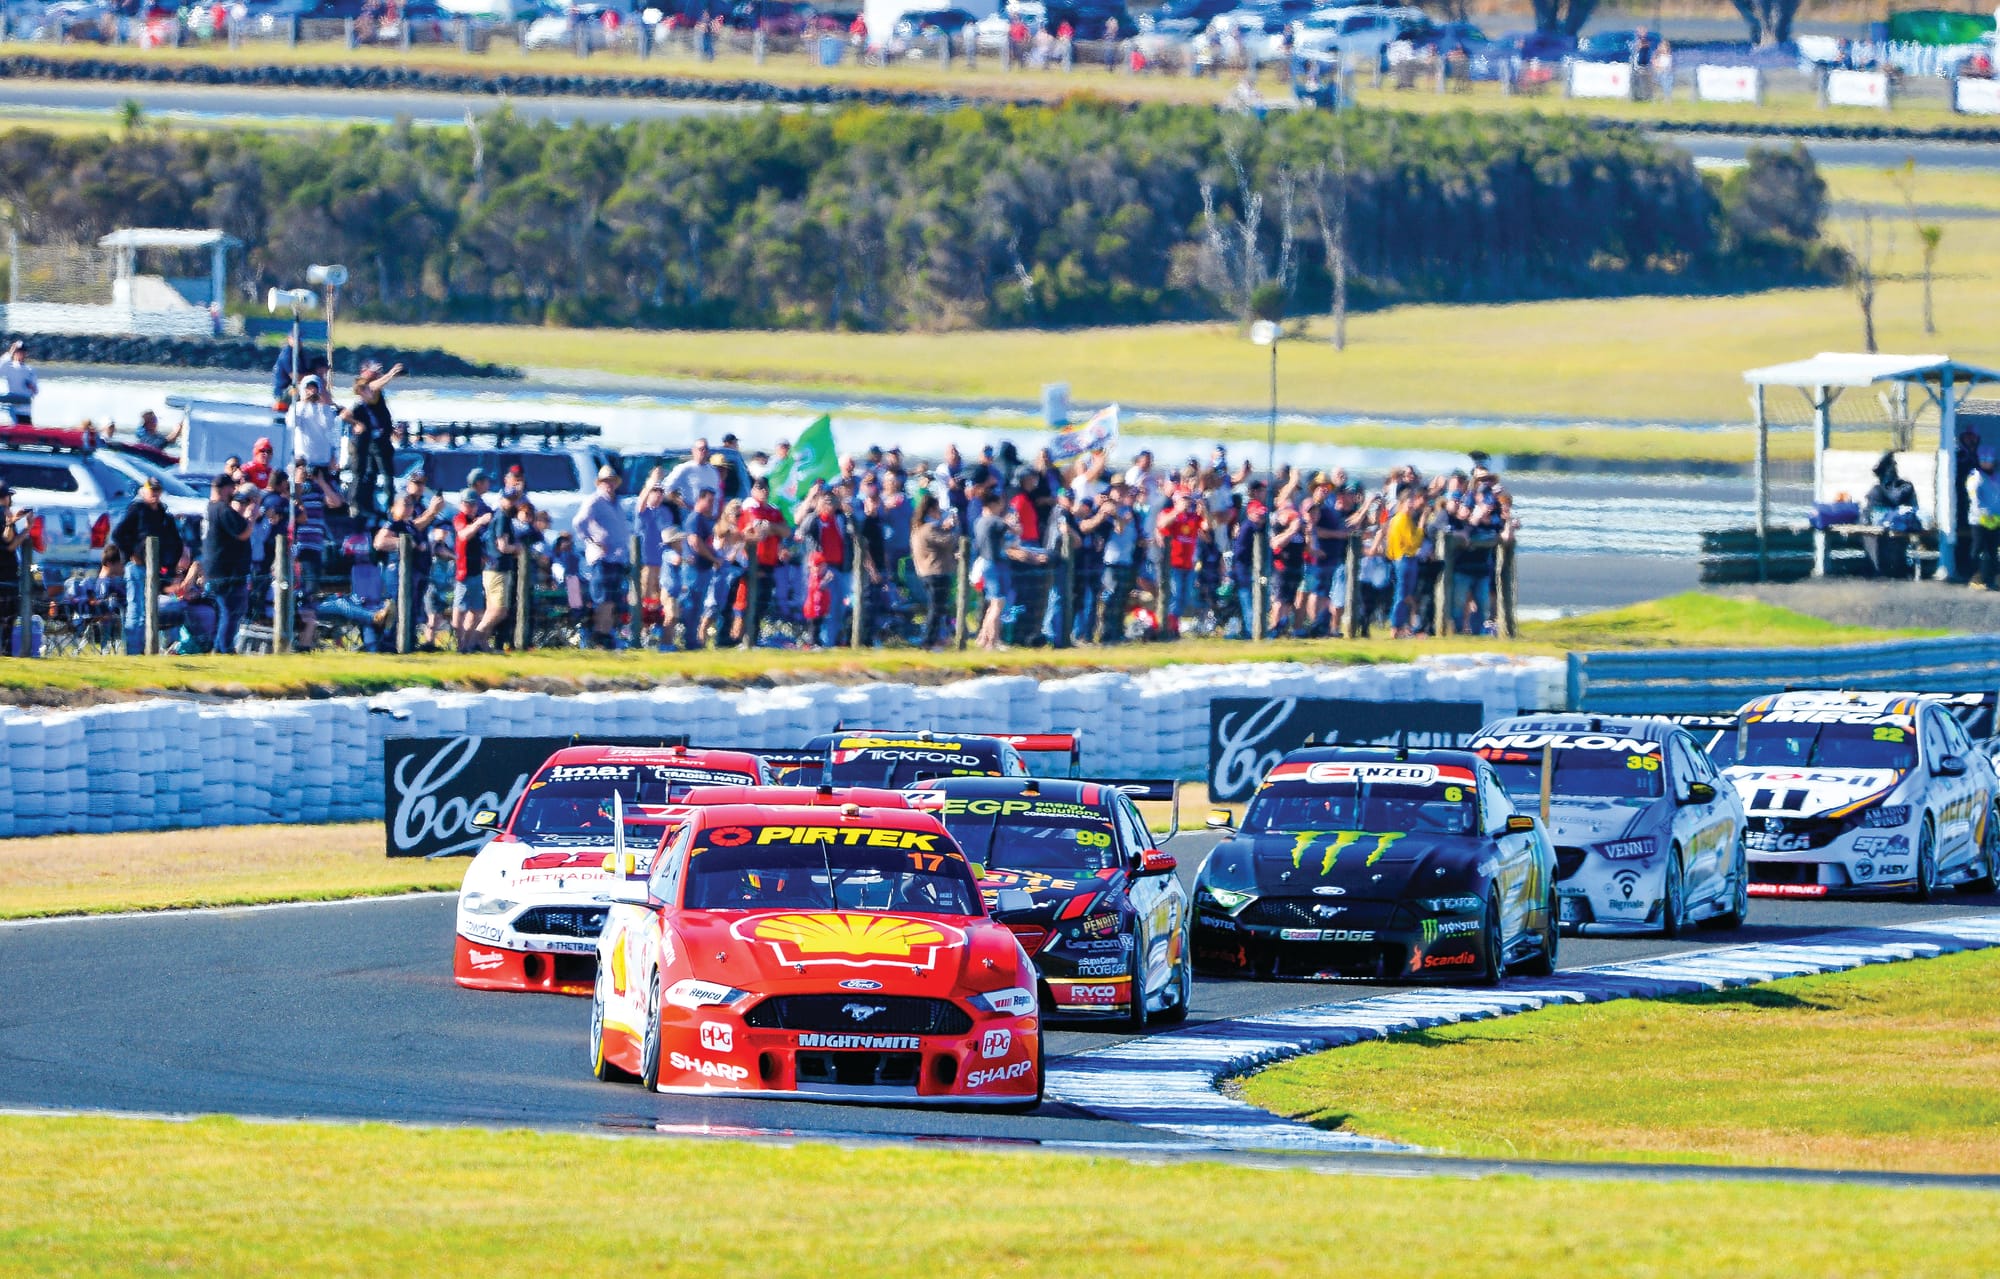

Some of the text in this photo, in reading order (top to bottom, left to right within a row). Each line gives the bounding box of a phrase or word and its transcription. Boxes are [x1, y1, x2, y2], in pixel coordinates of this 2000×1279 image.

[1760, 710, 1912, 726] MEGA
[1873, 728, 1905, 742] 22
[1471, 734, 1660, 753] NULON
[867, 750, 980, 766] TICKFORD
[1627, 755, 1658, 770] 35
[550, 765, 636, 778] imar
[713, 774, 747, 785] MATE
[1352, 767, 1424, 779] ENZED
[1724, 772, 1878, 787] Mobil
[1445, 787, 1463, 802] 6
[938, 800, 1032, 816] EGP
[1035, 802, 1086, 811] energy
[1036, 807, 1100, 817] solutions
[756, 826, 939, 851] PIRTEK
[1075, 830, 1111, 847] 99
[1605, 841, 1642, 858] VENN
[907, 852, 945, 872] 17
[1083, 913, 1119, 934] PENRITE
[1438, 920, 1480, 933] MONSTER
[1321, 930, 1376, 941] EDGE
[1424, 951, 1476, 968] Scandia
[689, 988, 721, 1001] Repco
[1071, 985, 1116, 997] RYCO
[703, 1024, 731, 1047] PPG
[984, 1032, 1010, 1055] PPG
[669, 1052, 749, 1082] SHARP
[966, 1060, 1032, 1088] SHARP
